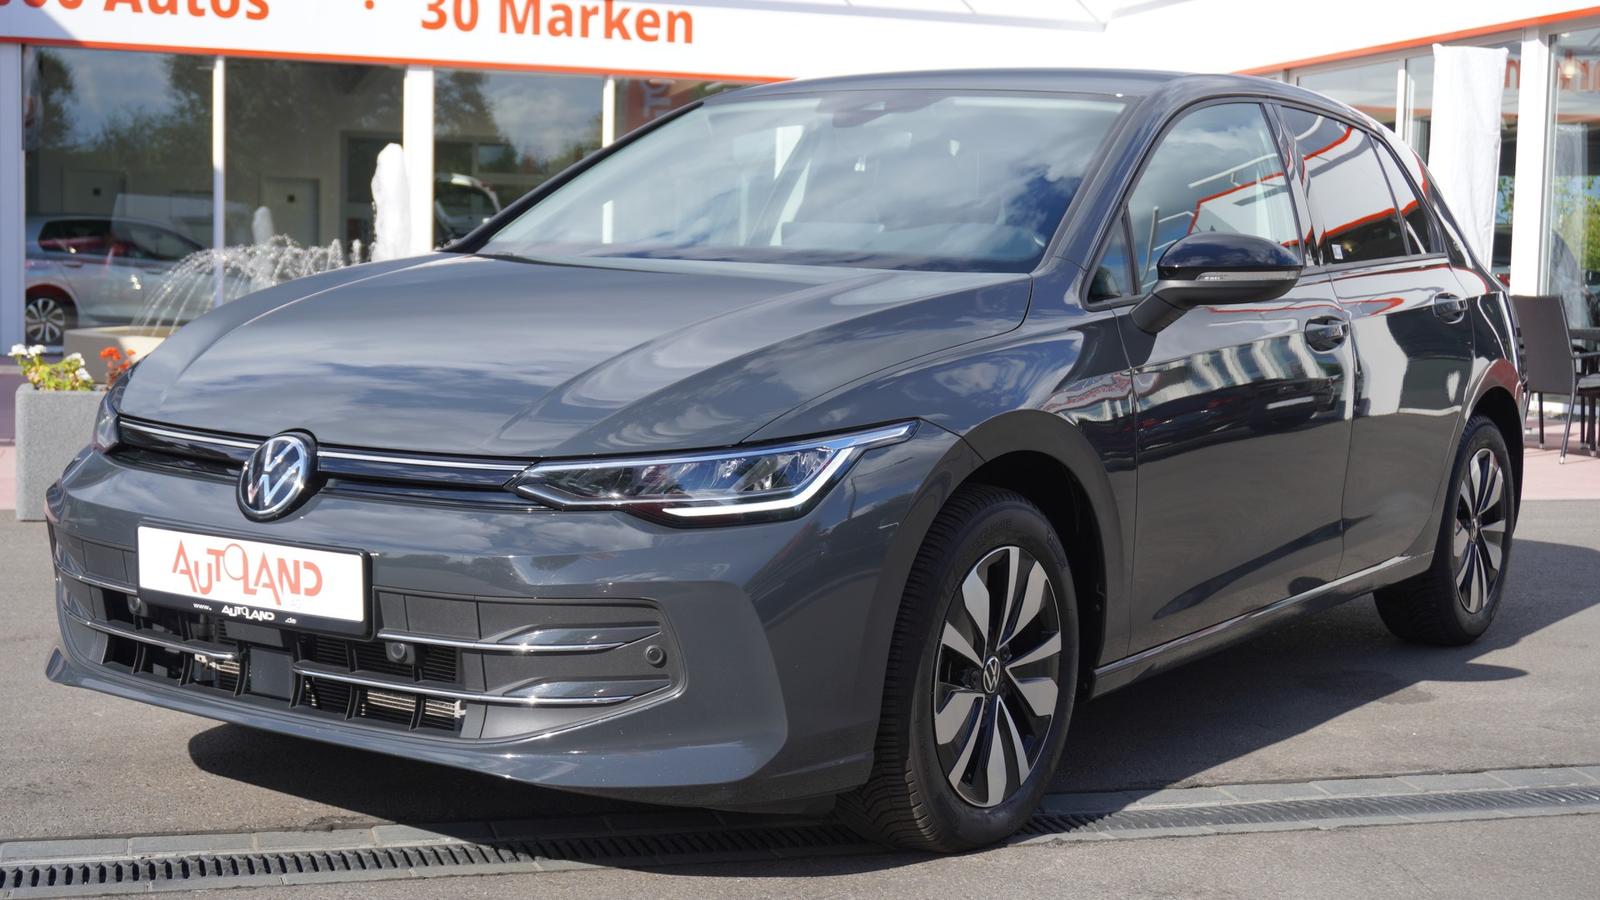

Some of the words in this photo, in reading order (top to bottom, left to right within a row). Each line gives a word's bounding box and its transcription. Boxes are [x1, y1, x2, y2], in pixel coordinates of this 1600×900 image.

[103, 0, 270, 21] utos
[420, 0, 479, 32] 30
[499, 0, 694, 45] Marken
[172, 539, 323, 606] AUTOLAND
